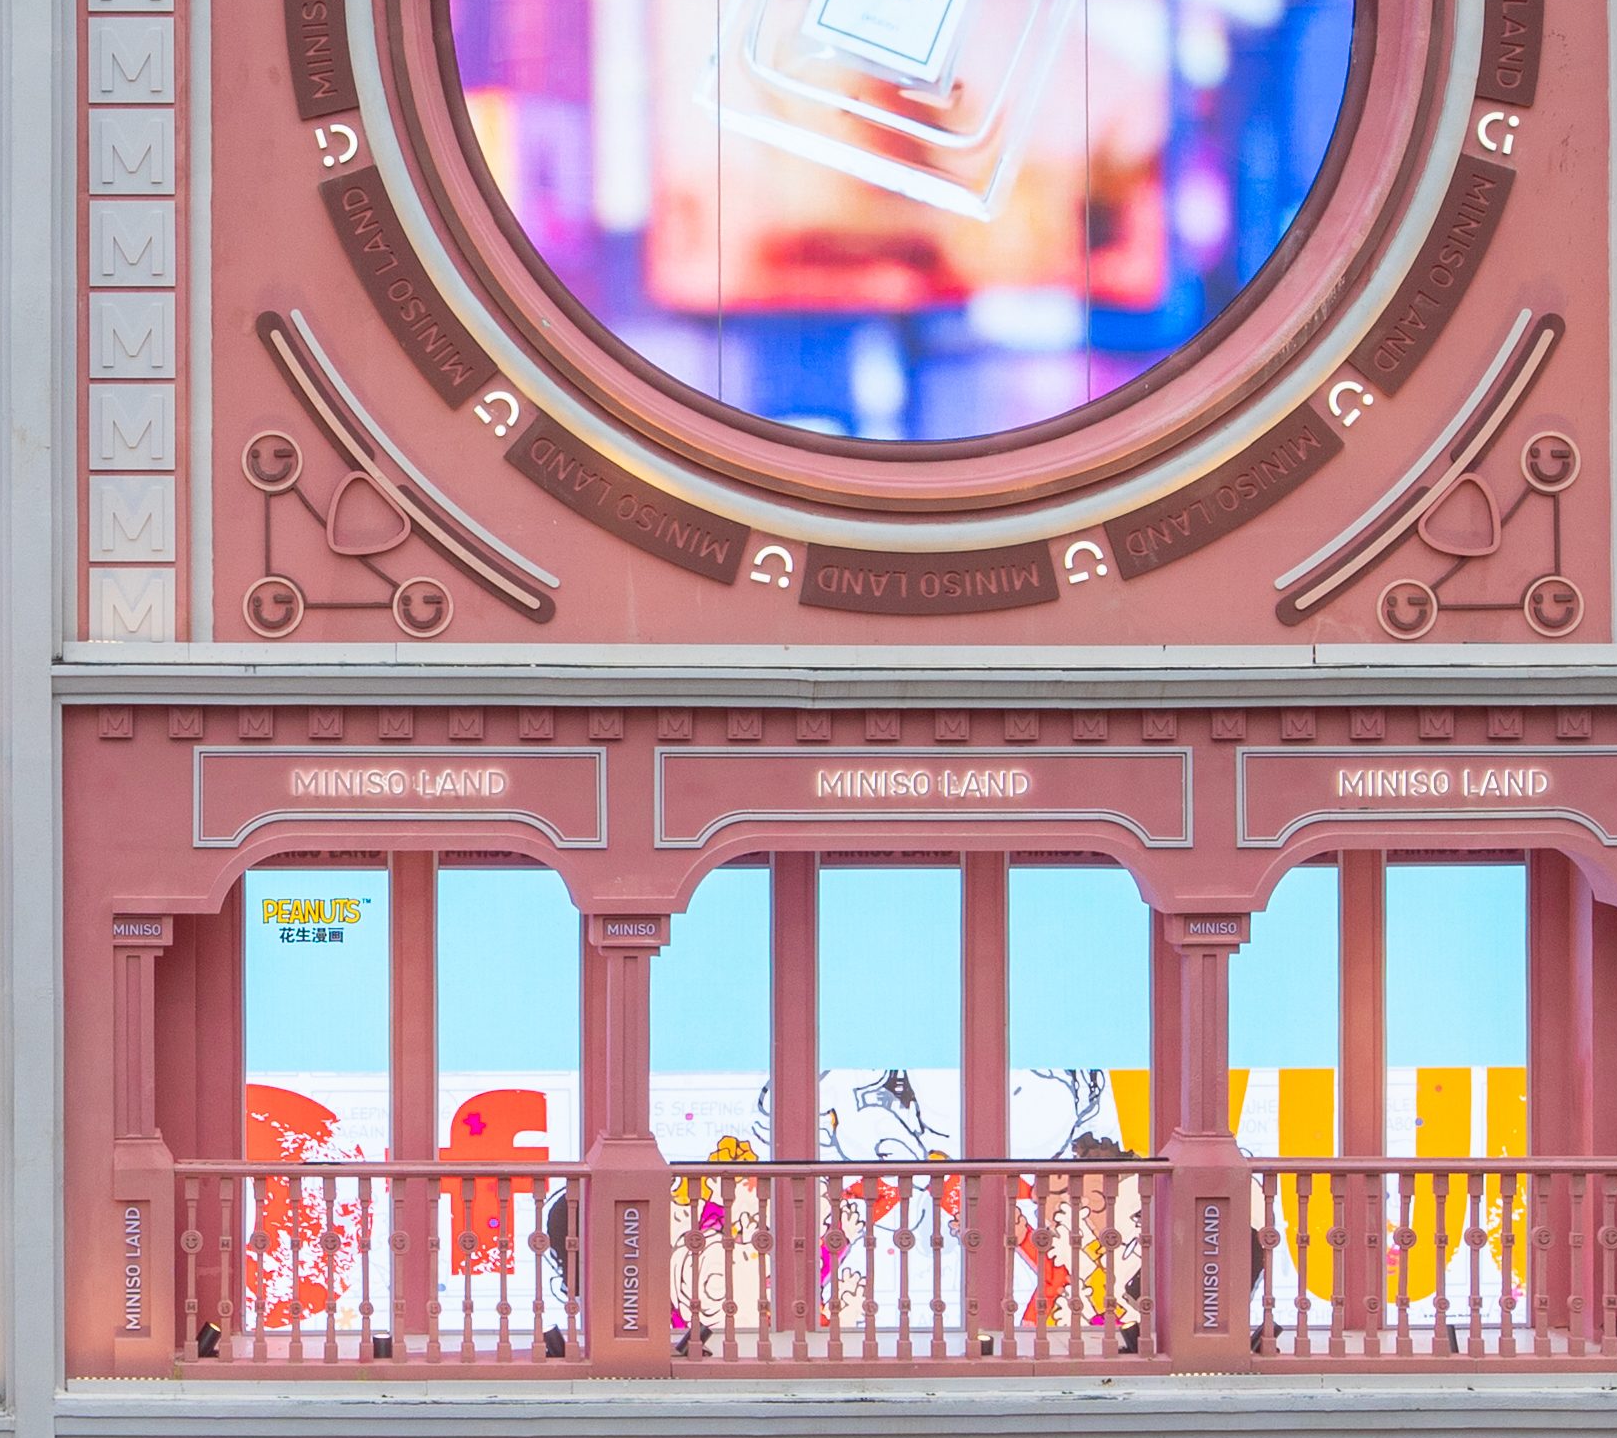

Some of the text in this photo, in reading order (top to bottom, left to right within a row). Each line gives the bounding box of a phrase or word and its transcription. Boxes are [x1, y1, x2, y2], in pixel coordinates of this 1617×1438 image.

[292, 769, 508, 797] MINISO LAND
[817, 770, 1030, 798] MINISO LAND
[1338, 769, 1550, 797] MINISO LAND
[262, 897, 361, 926] PEANUTS
[114, 924, 161, 936] MINISO
[279, 927, 344, 944] 花生漫画
[608, 924, 655, 936] MINISO
[1190, 921, 1237, 934] MINISO
[125, 1206, 141, 1330] MINISO LAND
[1204, 1205, 1219, 1328] MINISO LAND
